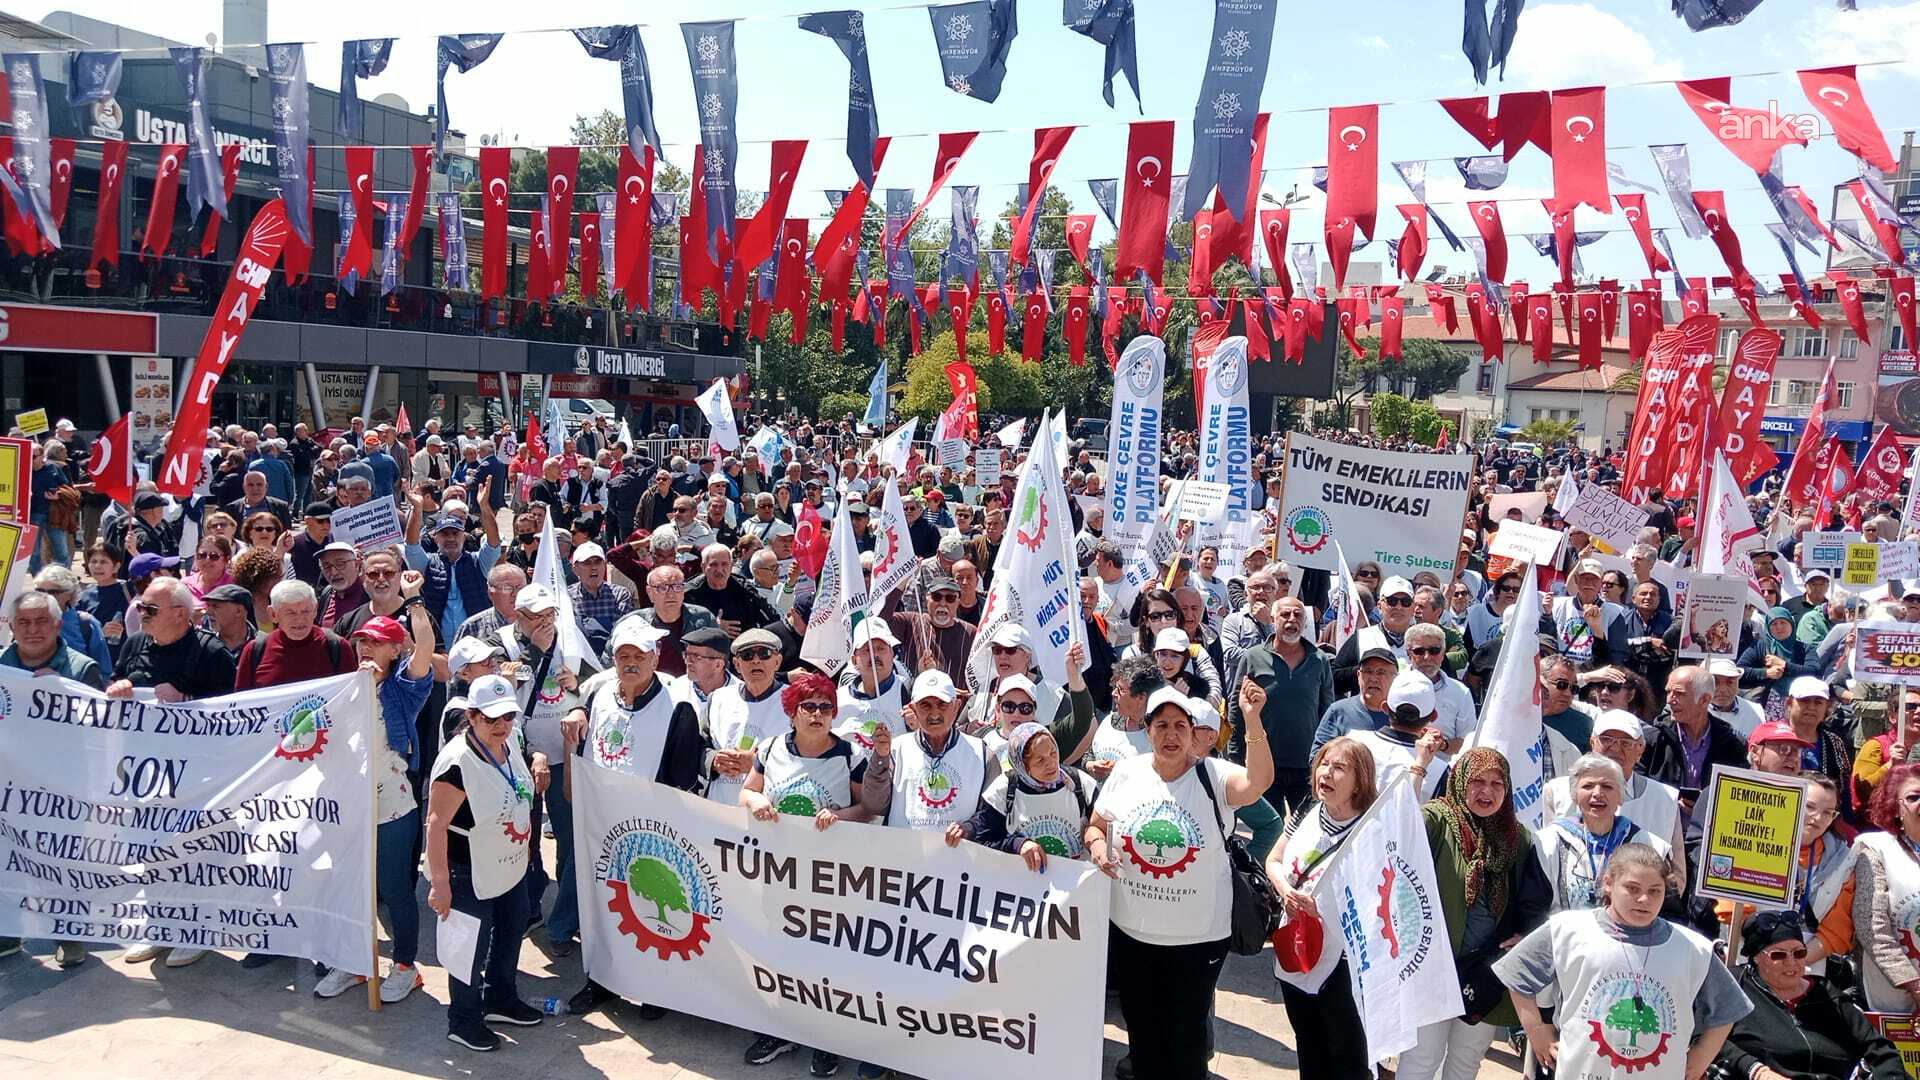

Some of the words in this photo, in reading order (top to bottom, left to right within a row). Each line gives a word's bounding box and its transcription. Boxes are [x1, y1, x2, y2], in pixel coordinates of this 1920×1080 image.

[136, 109, 188, 145] USTA
[236, 258, 272, 289] CHP
[597, 350, 623, 375] USTA
[1646, 368, 1679, 384] CHP
[1734, 364, 1771, 384] CHP
[164, 291, 250, 487] AYDN
[1116, 401, 1135, 464] ÇEVRE
[1205, 403, 1222, 465] ÇEVRE
[1760, 421, 1795, 432] RKCELL
[1135, 406, 1159, 525] PLATFORMU
[1227, 405, 1249, 524] PLATFORMU
[1289, 446, 1334, 473] TÜM
[1337, 459, 1470, 492] EMEKLİLERİN
[1111, 471, 1130, 524] SÖKE
[1322, 482, 1430, 517] SENDİKASI
[1583, 482, 1650, 524] SEFALET
[1580, 515, 1618, 541] SON
[1374, 550, 1401, 566] Tire
[1404, 550, 1455, 572] Şubesi
[27, 689, 151, 733] SEFALET
[109, 755, 188, 799] SON
[241, 792, 341, 826] SÜRÜYOR
[1730, 786, 1788, 809] DEMOKRATİK
[1744, 805, 1766, 822] LAİK
[36, 830, 180, 866] EMEKLİLERİN
[183, 825, 299, 855] SENDİKASI
[1734, 820, 1771, 840] TÜRKİYE
[1149, 857, 1166, 865] 2017
[1756, 841, 1784, 858] YAŞAM
[170, 861, 293, 892] PLATFORMU
[602, 815, 679, 852] EMEKLİLERİN
[680, 836, 723, 922] SENDİKASI
[713, 835, 797, 890] TÜM
[811, 859, 1082, 942] EMEKLİLERİN
[1136, 882, 1198, 895] EMEKLİLERİN
[112, 899, 199, 923] DENİZLİ
[219, 906, 299, 929] MUĞLA
[52, 918, 95, 938] EGE
[180, 925, 270, 950] MİTİNGİ
[782, 904, 998, 985] SENDİKASI
[752, 964, 888, 1027] DENİZLİ
[898, 1003, 1038, 1056] ŞUBESİ
